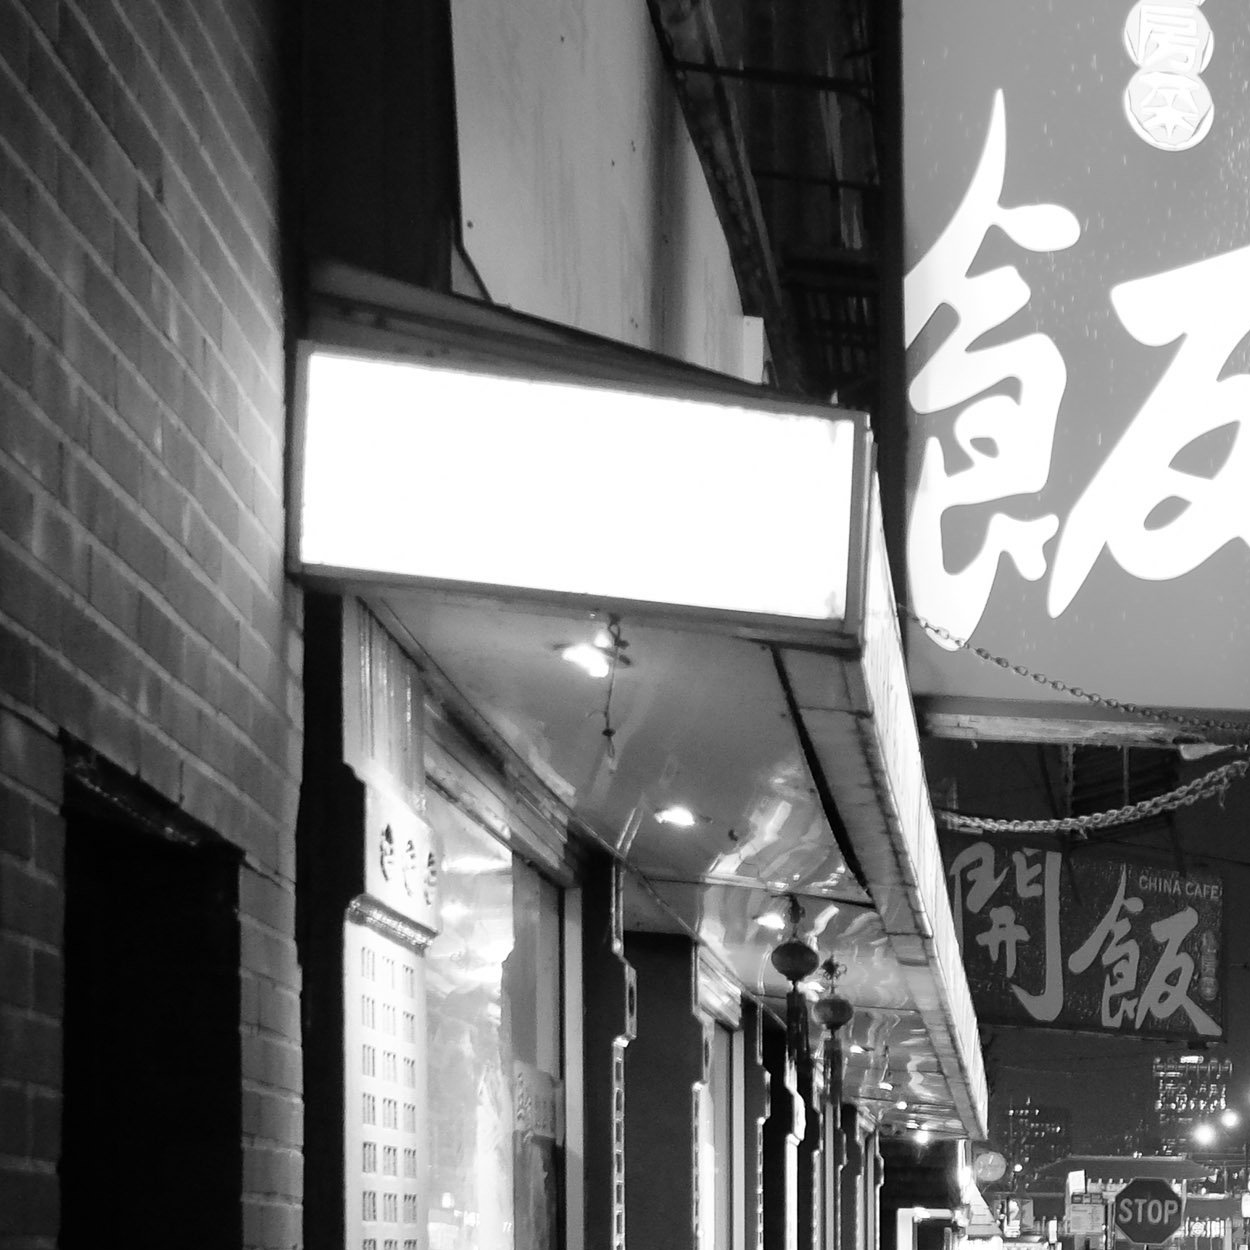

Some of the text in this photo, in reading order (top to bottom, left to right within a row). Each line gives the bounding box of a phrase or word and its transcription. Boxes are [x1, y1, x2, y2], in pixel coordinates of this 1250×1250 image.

[1138, 874, 1219, 900] CHINA CAFE
[1117, 1197, 1179, 1225] STOP
